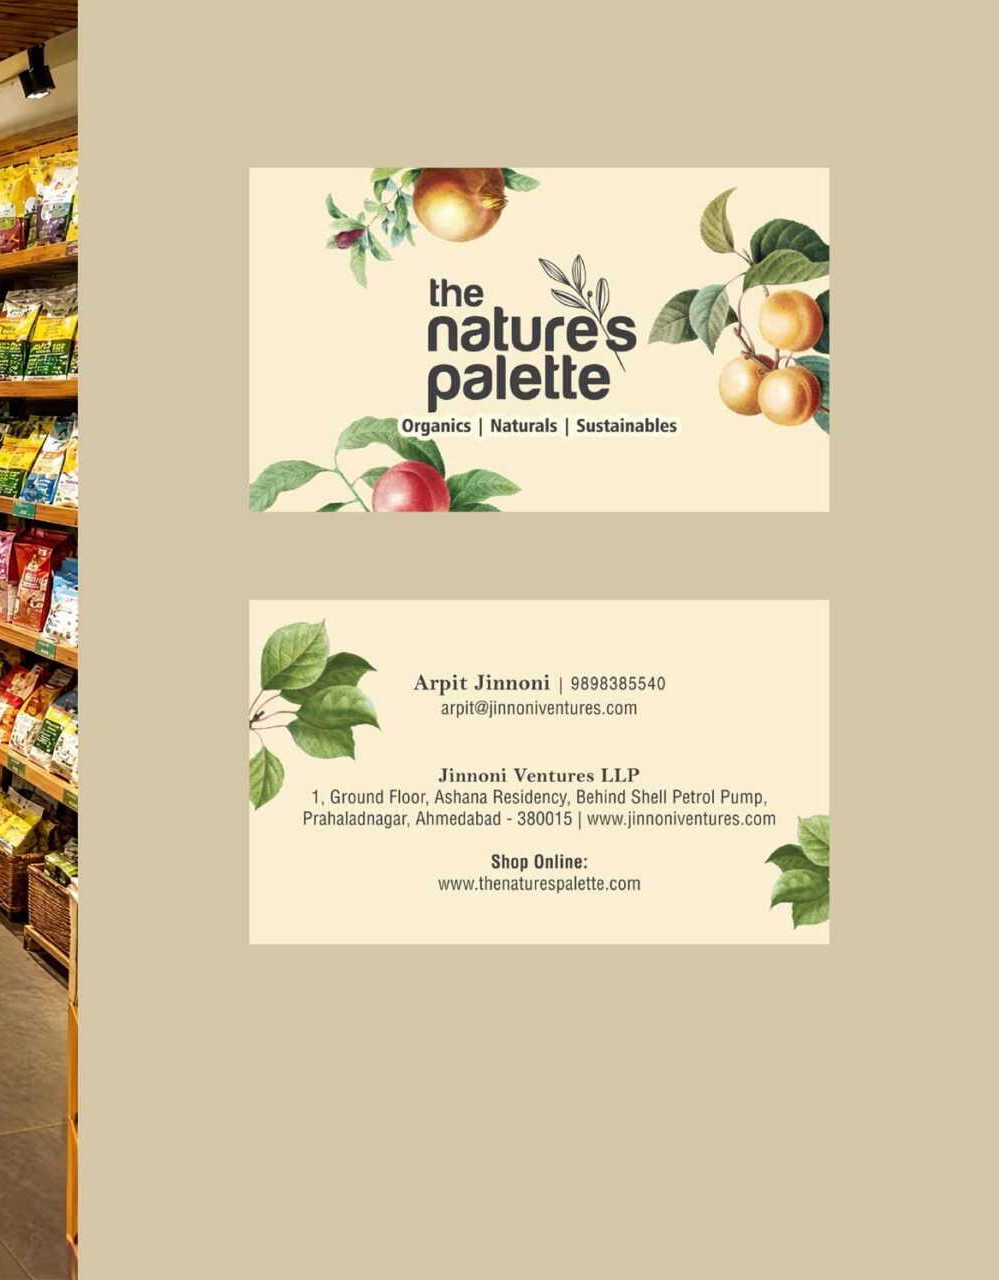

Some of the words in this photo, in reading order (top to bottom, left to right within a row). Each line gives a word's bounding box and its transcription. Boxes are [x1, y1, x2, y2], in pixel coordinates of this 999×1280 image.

[430, 278, 484, 308] the
[427, 354, 611, 413] palette
[401, 418, 471, 437] Organics
[490, 417, 558, 433] Naturals
[576, 417, 677, 433] Sustainables
[413, 674, 468, 696] Arpit
[474, 674, 550, 691] Jinnoni
[570, 676, 666, 691] 9898385540
[441, 700, 637, 718] arpit@jinnoniventures.com
[438, 767, 507, 783] Jinnoni
[513, 767, 595, 783] Ventures
[601, 768, 640, 783] LLP
[312, 789, 325, 806] 1,
[330, 789, 384, 805] Ground
[389, 789, 429, 807] Floor,
[434, 789, 488, 805] Ashana
[493, 789, 571, 808] Residency,
[576, 789, 626, 805] Behind
[631, 789, 667, 805] Shell
[672, 789, 715, 805] Petrol
[720, 790, 767, 808] Pump,
[303, 811, 410, 830] Prahaladnagar,
[415, 811, 501, 826] Ahmedabad
[518, 811, 573, 826] 380015
[586, 811, 776, 830] www.jinnoniventures.com
[491, 853, 529, 872] Shop
[534, 853, 588, 870] Online:
[438, 876, 641, 894] www.thenaturespalette.com
